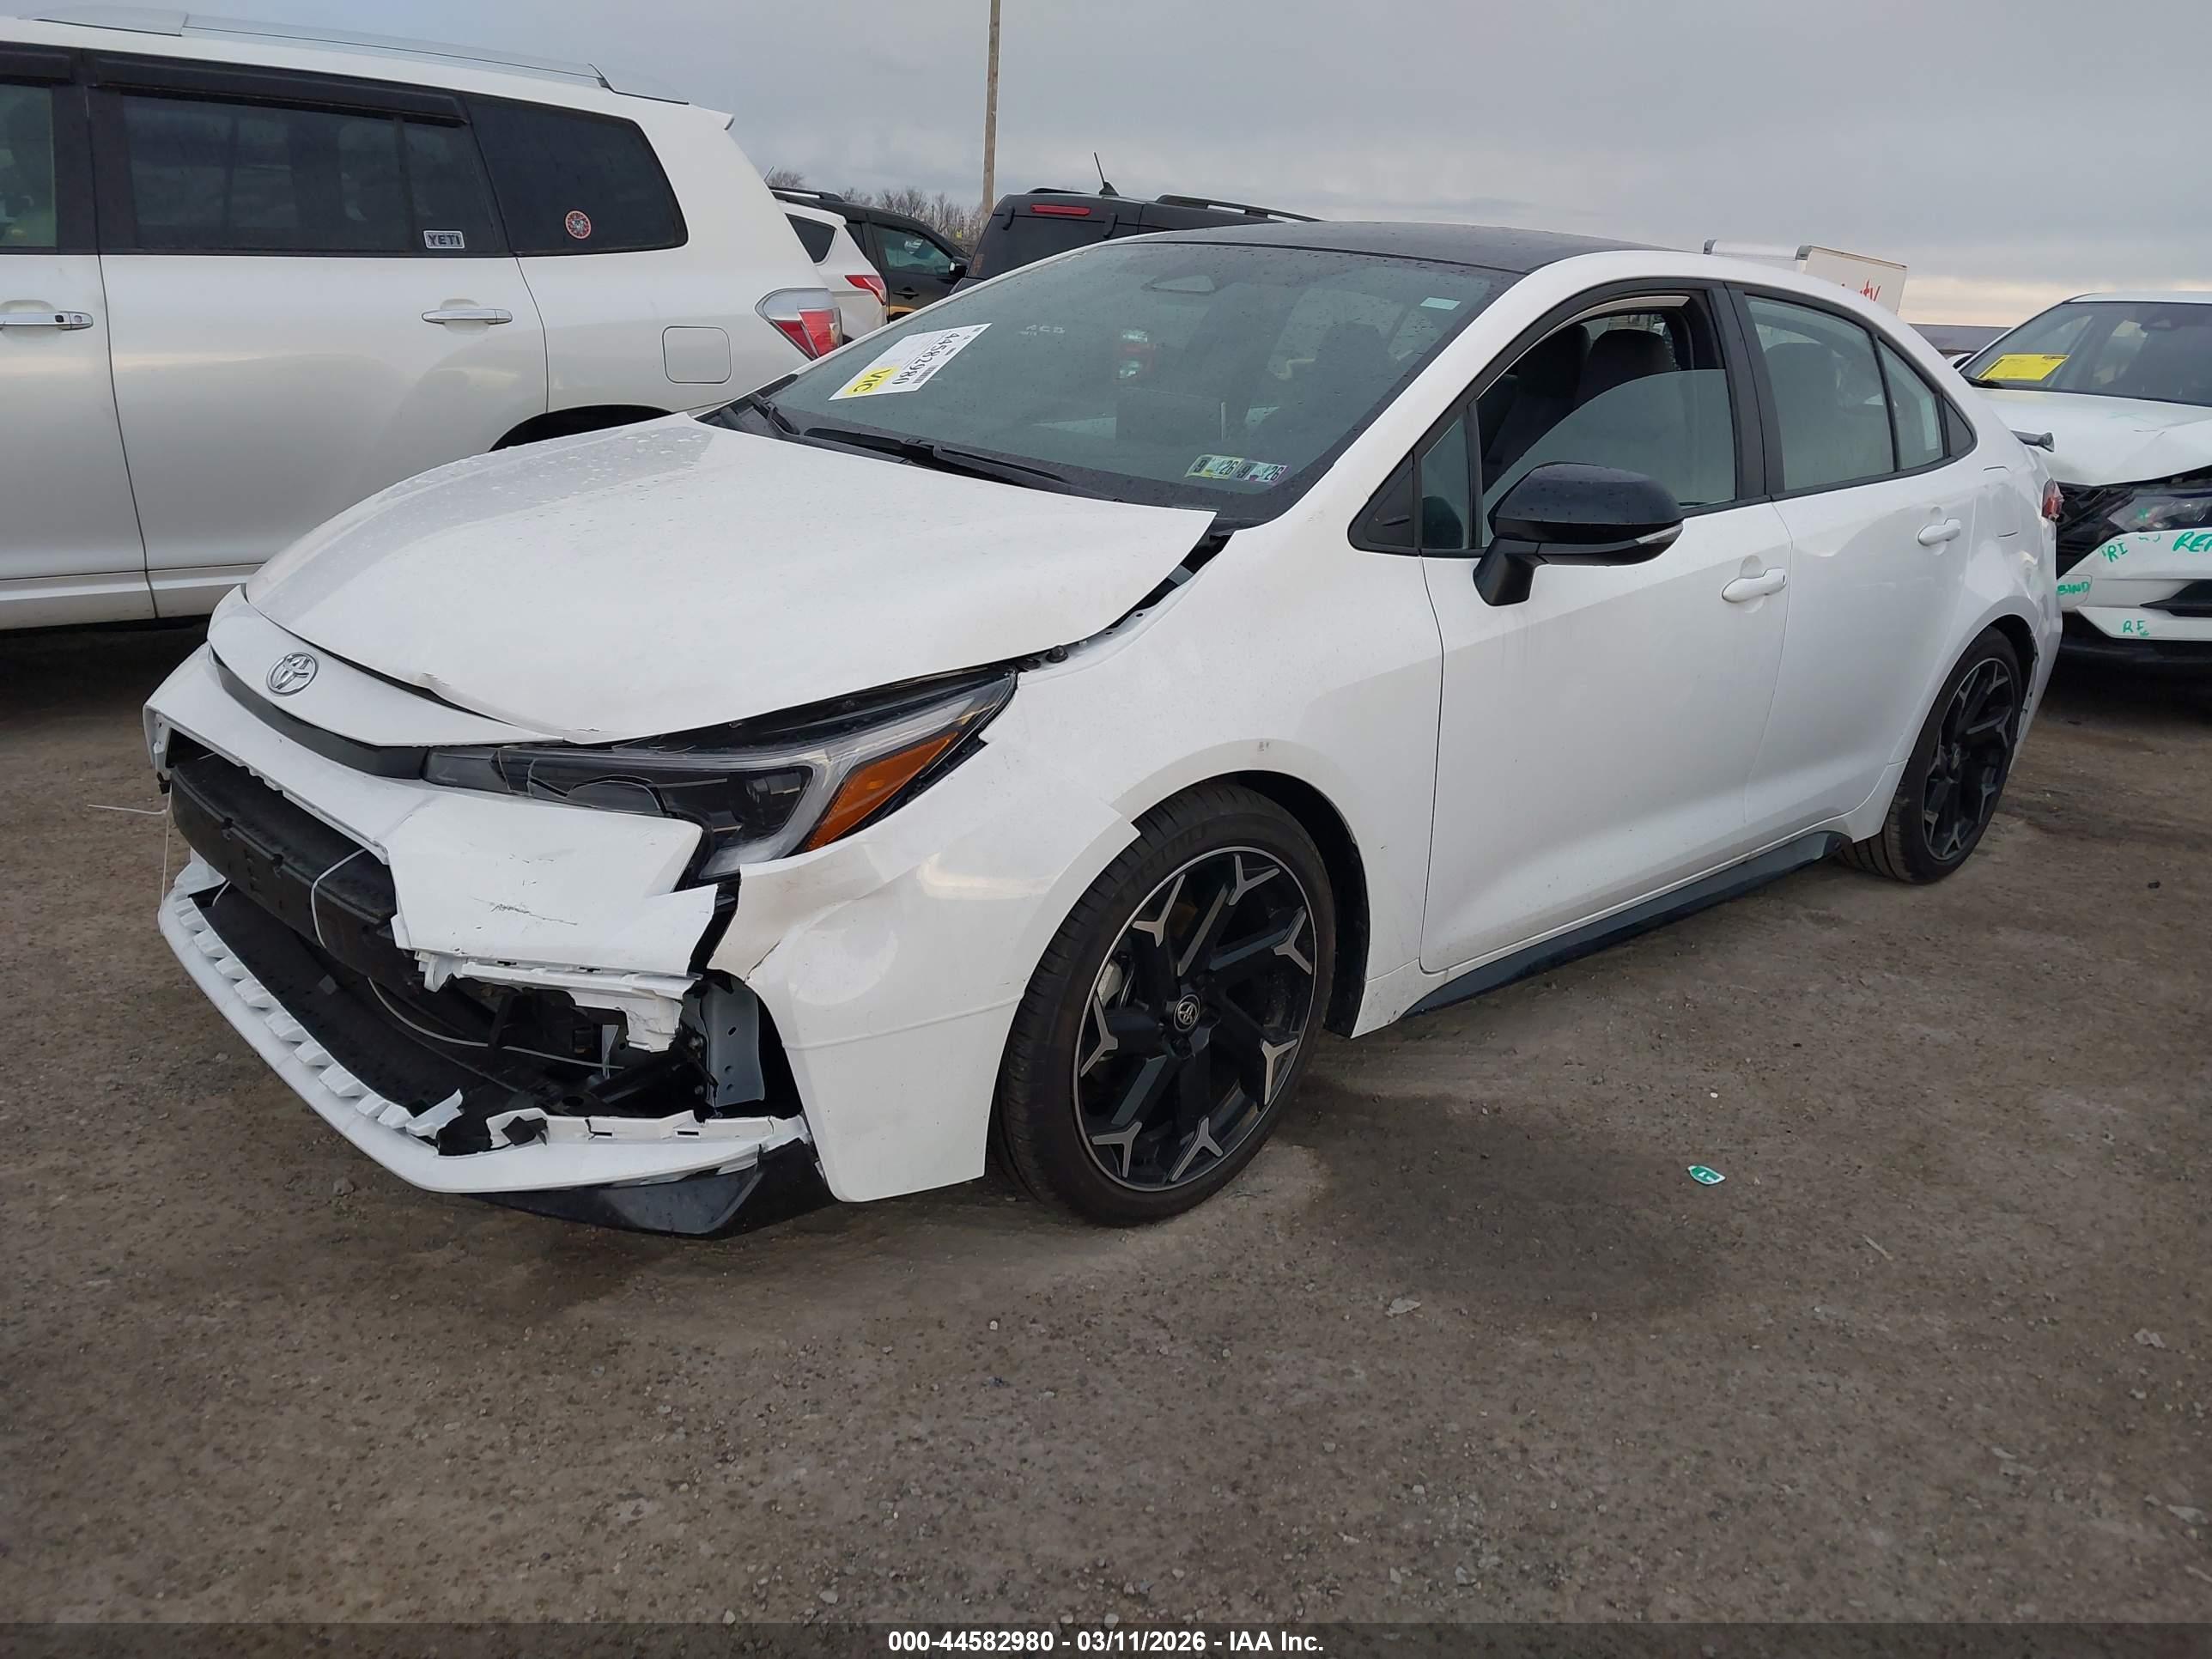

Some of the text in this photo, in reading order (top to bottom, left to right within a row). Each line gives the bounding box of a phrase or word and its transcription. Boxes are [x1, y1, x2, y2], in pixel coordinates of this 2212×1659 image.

[428, 234, 461, 246] YETI
[891, 331, 961, 385] 44582980
[853, 368, 892, 392] VIC
